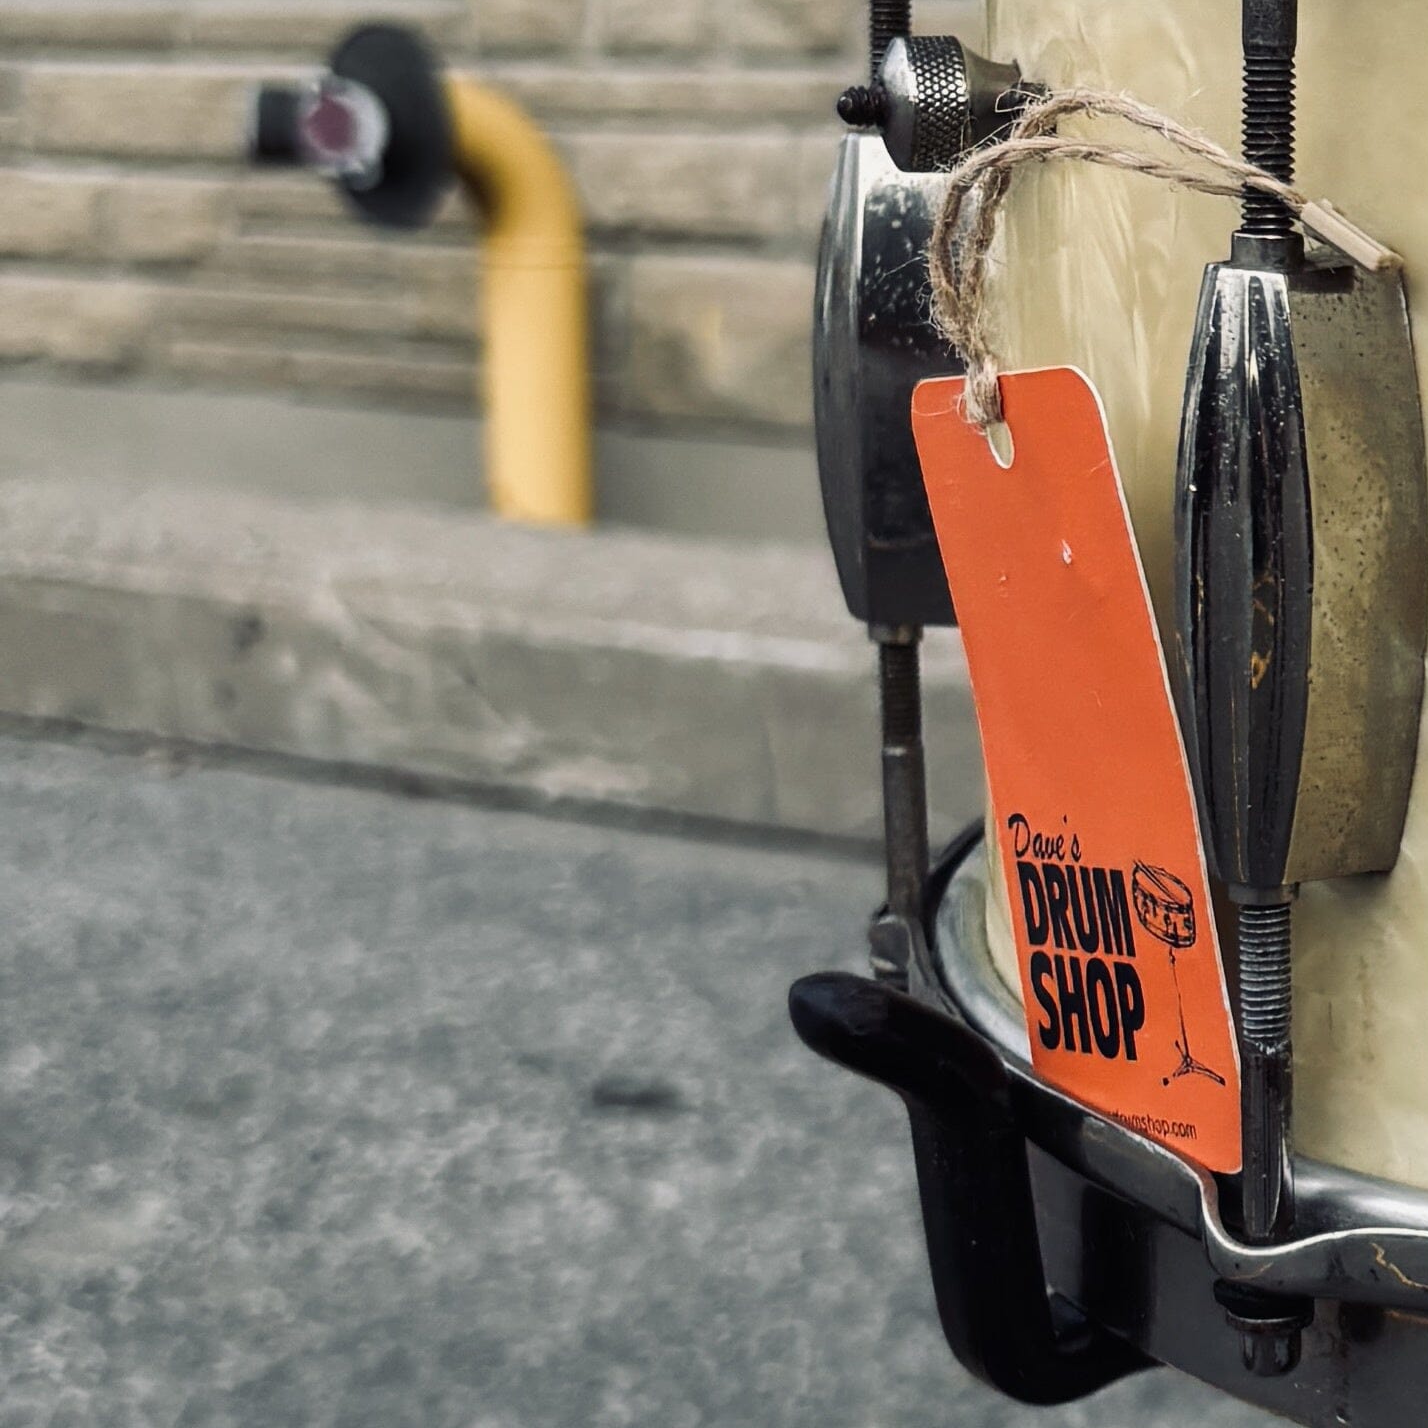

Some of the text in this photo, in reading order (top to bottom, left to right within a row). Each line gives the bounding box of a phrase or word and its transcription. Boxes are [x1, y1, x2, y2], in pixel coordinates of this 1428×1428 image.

[1008, 813, 1082, 862] Dave's
[1017, 861, 1136, 957] DRUM
[1030, 951, 1145, 1061] SHOP
